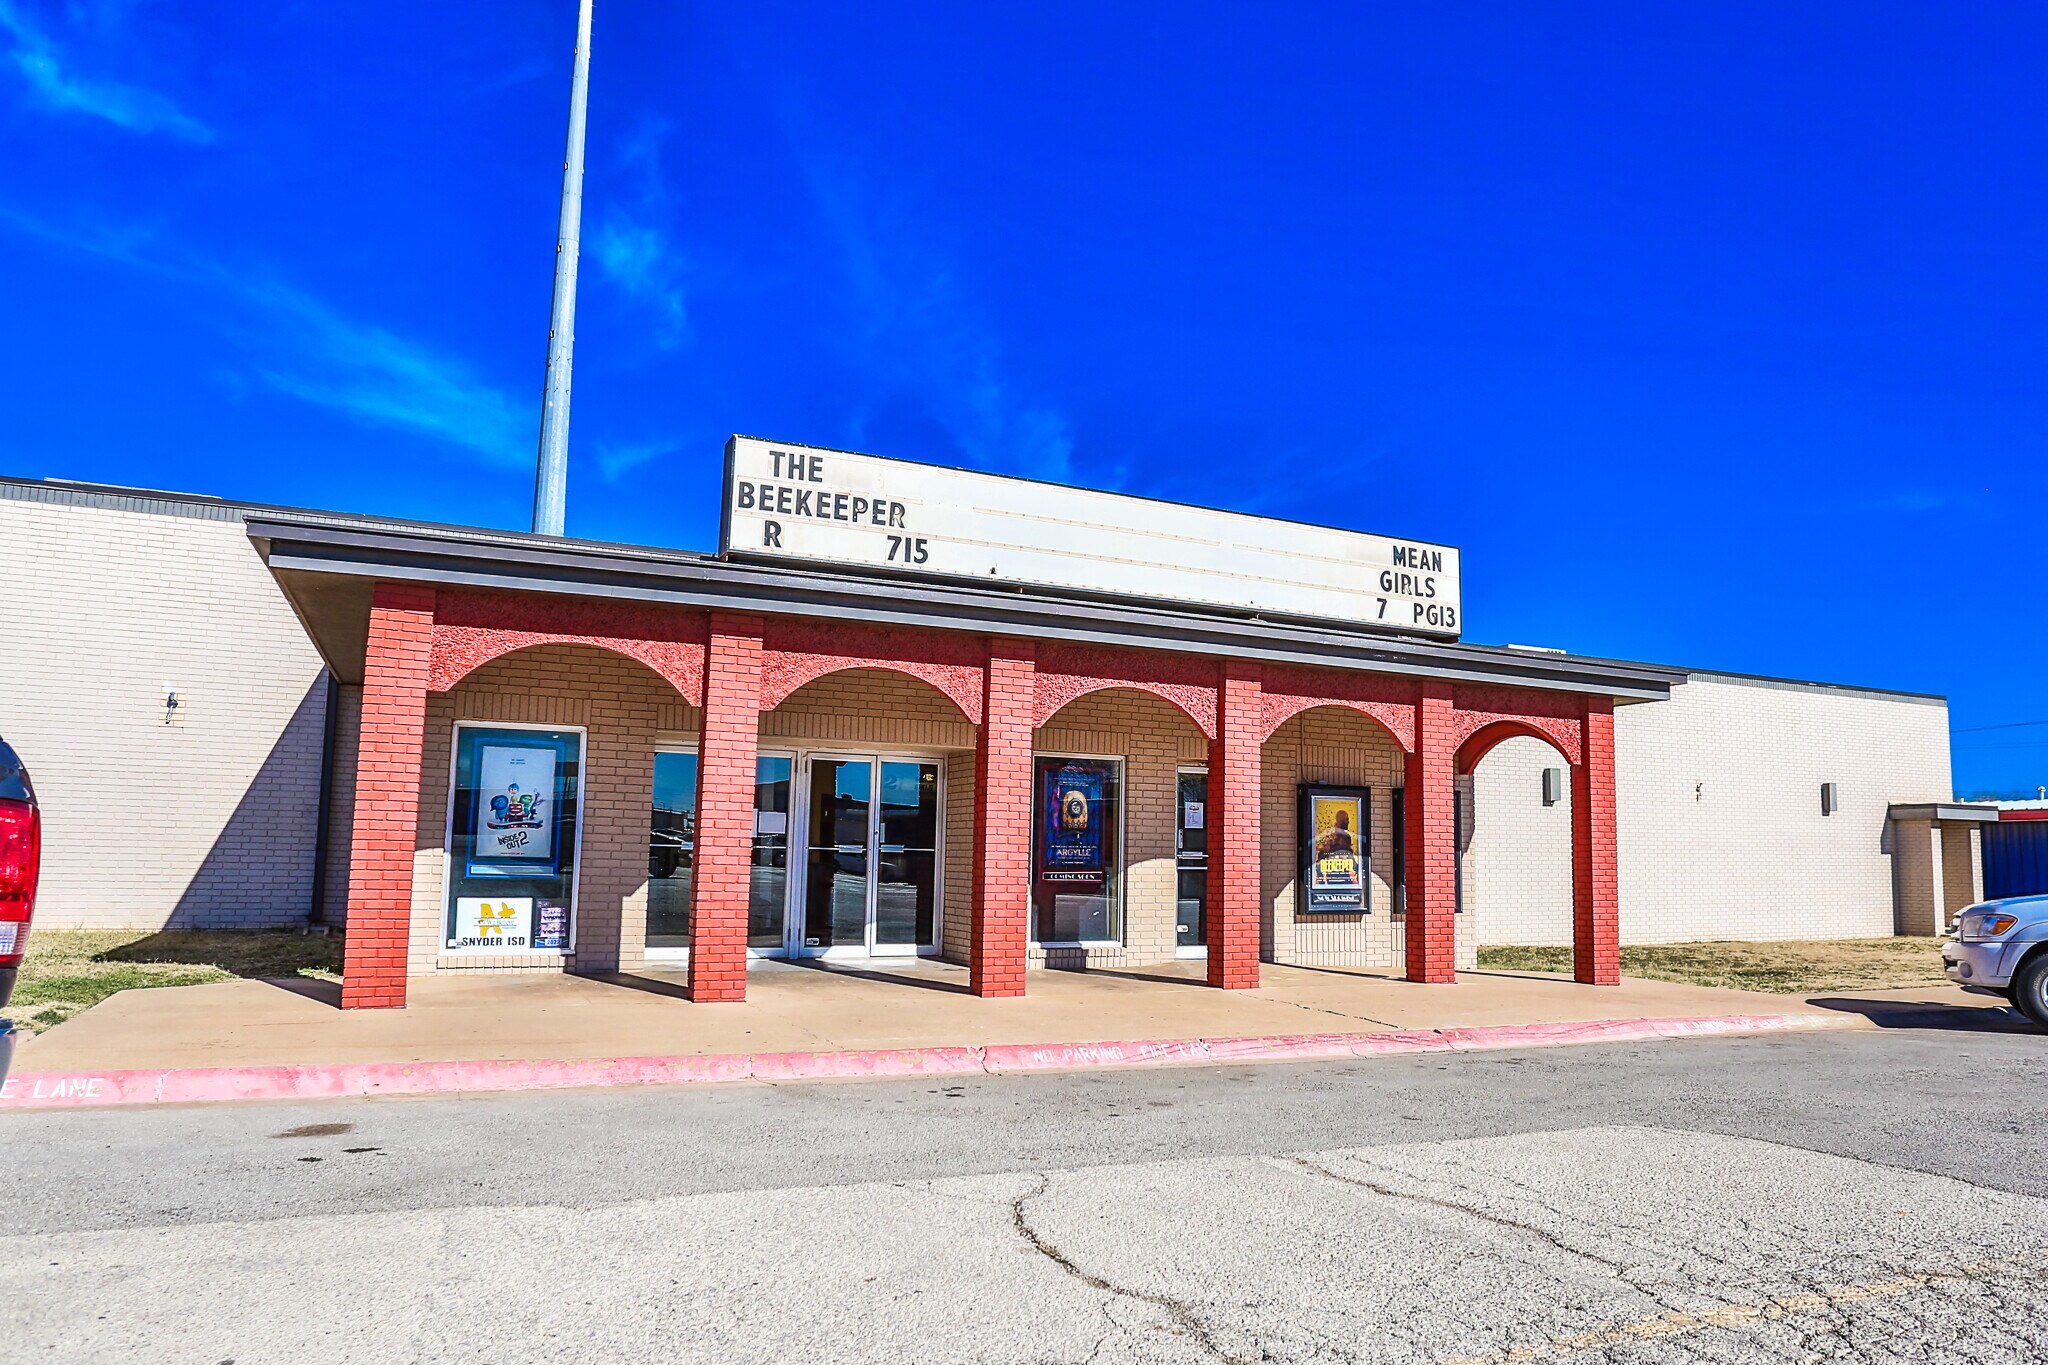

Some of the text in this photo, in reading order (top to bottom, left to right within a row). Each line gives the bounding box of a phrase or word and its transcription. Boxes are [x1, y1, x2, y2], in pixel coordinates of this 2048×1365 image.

[769, 450, 823, 483] THE
[738, 481, 906, 529] BEEKEEPER
[763, 519, 929, 564] R 715
[1392, 545, 1442, 572] MEAN
[1379, 570, 1435, 598] GIRLS
[1376, 597, 1456, 628] 7 PG13
[497, 832, 519, 846] INSIDE
[506, 830, 530, 850] OUT 2
[1056, 848, 1092, 857] ARGYLLE
[461, 937, 503, 947] SNYDER
[507, 936, 526, 946] ISD
[1033, 1049, 1054, 1064] NO
[1063, 1045, 1124, 1064] PARKING
[1140, 1043, 1173, 1060] FIRE
[31, 1077, 105, 1099] LANE
